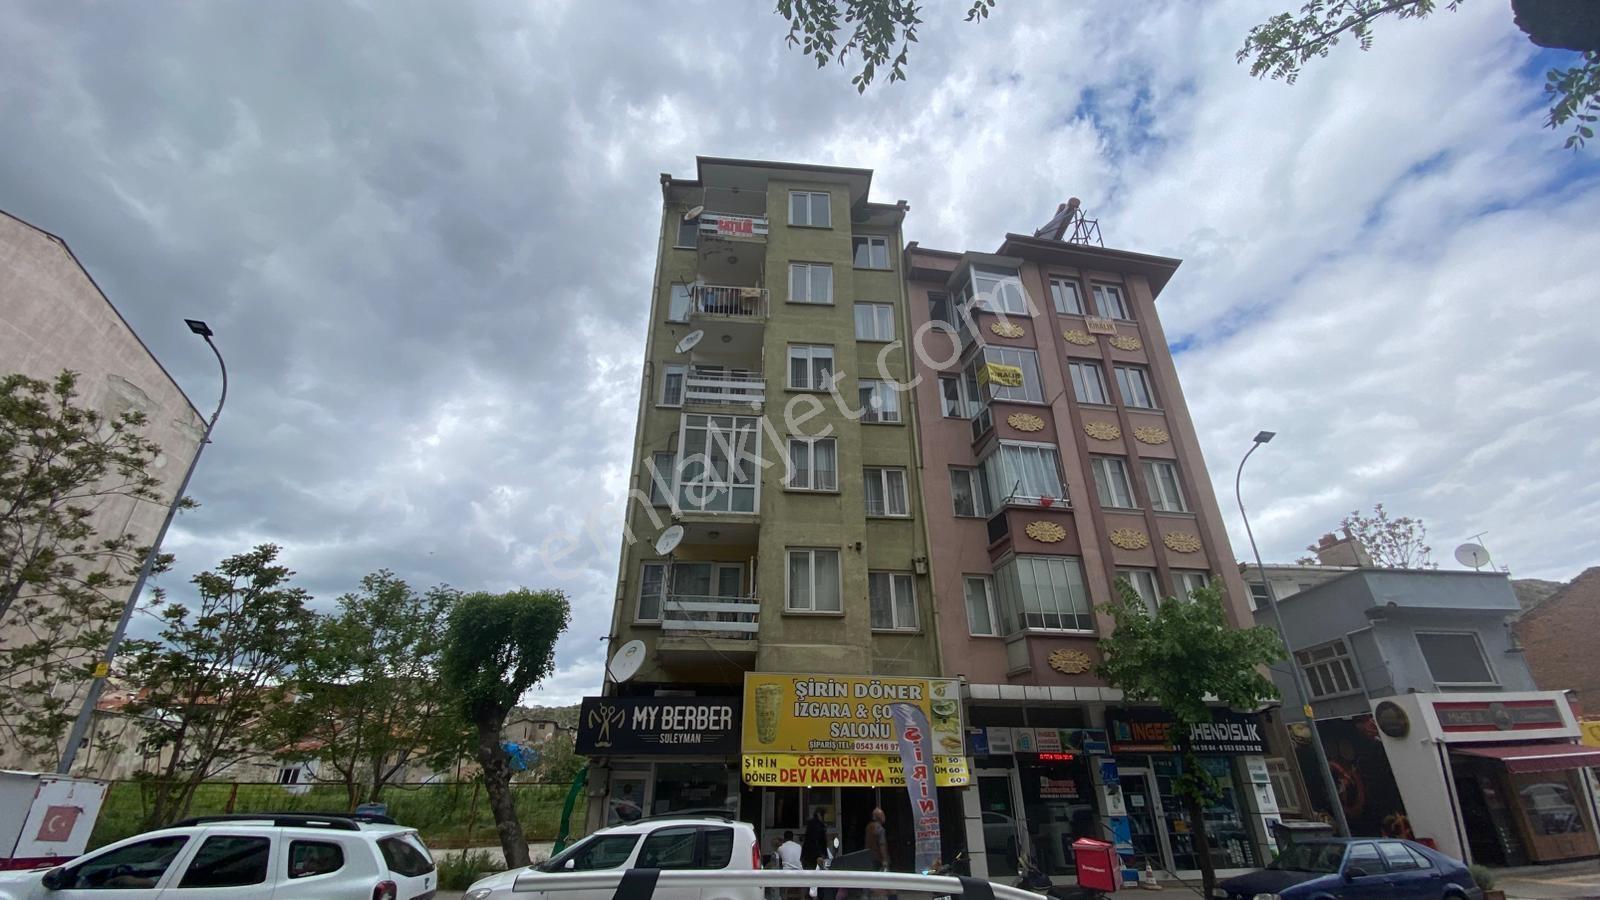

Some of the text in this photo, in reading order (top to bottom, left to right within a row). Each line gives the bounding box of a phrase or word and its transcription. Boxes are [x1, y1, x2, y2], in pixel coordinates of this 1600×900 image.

[795, 678, 922, 700] ŞİRİN DÖNER
[632, 705, 733, 731] MY BERBER
[855, 704, 868, 718] &
[872, 705, 892, 722] ÇO
[830, 722, 891, 739] SALONU
[1189, 719, 1262, 741] HENDİSLİK
[838, 741, 850, 750] TEL
[855, 742, 874, 750] 0543
[875, 743, 889, 751] 416
[745, 756, 777, 768] ŞİRİN
[797, 753, 867, 767] ÖĞRENCİYE
[745, 771, 777, 783] DÖNER
[780, 768, 885, 783] DEV KAMPANYA
[934, 766, 947, 774] ÜM
